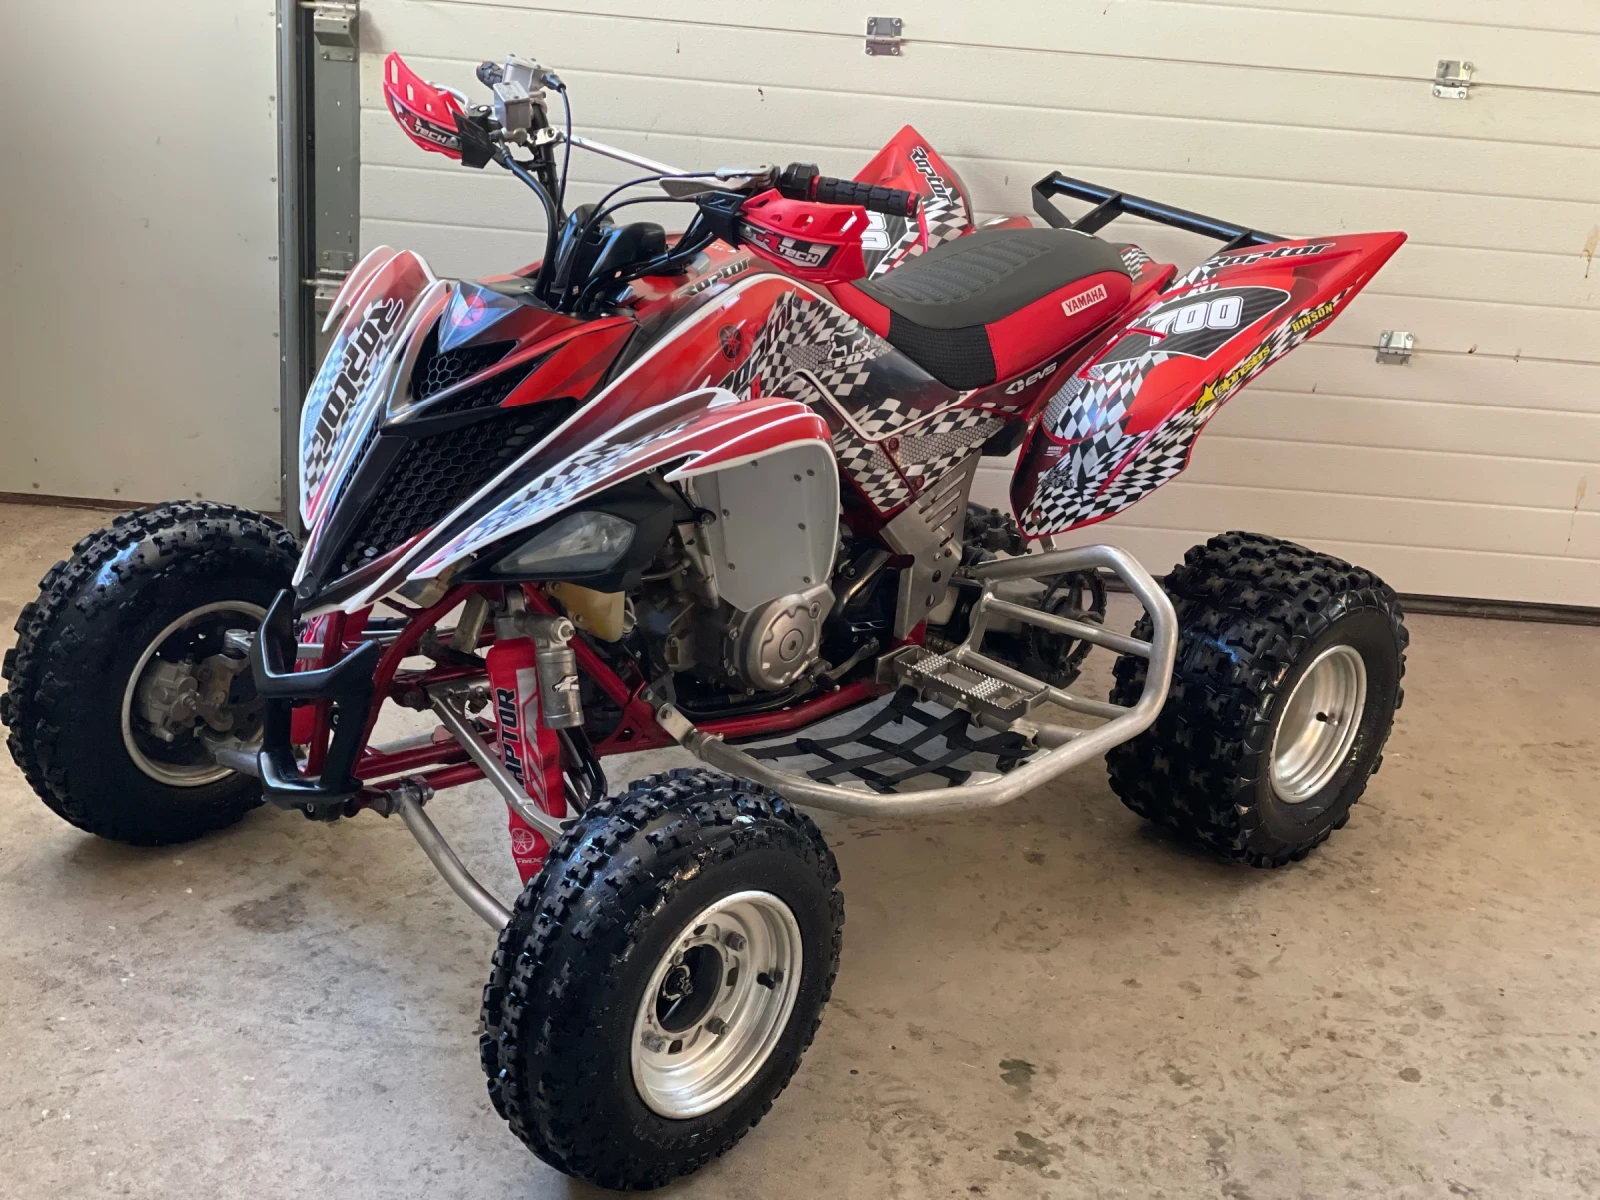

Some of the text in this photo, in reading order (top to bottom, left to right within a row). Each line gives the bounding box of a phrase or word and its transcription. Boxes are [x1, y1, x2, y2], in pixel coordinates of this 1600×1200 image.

[778, 245, 821, 265] TECH
[1065, 287, 1106, 313] YAMAHA
[1145, 295, 1244, 347] 700
[1291, 303, 1333, 333] HINSON
[832, 348, 877, 369] FOX
[1025, 361, 1057, 387] EVS
[496, 686, 527, 793] APTOR
